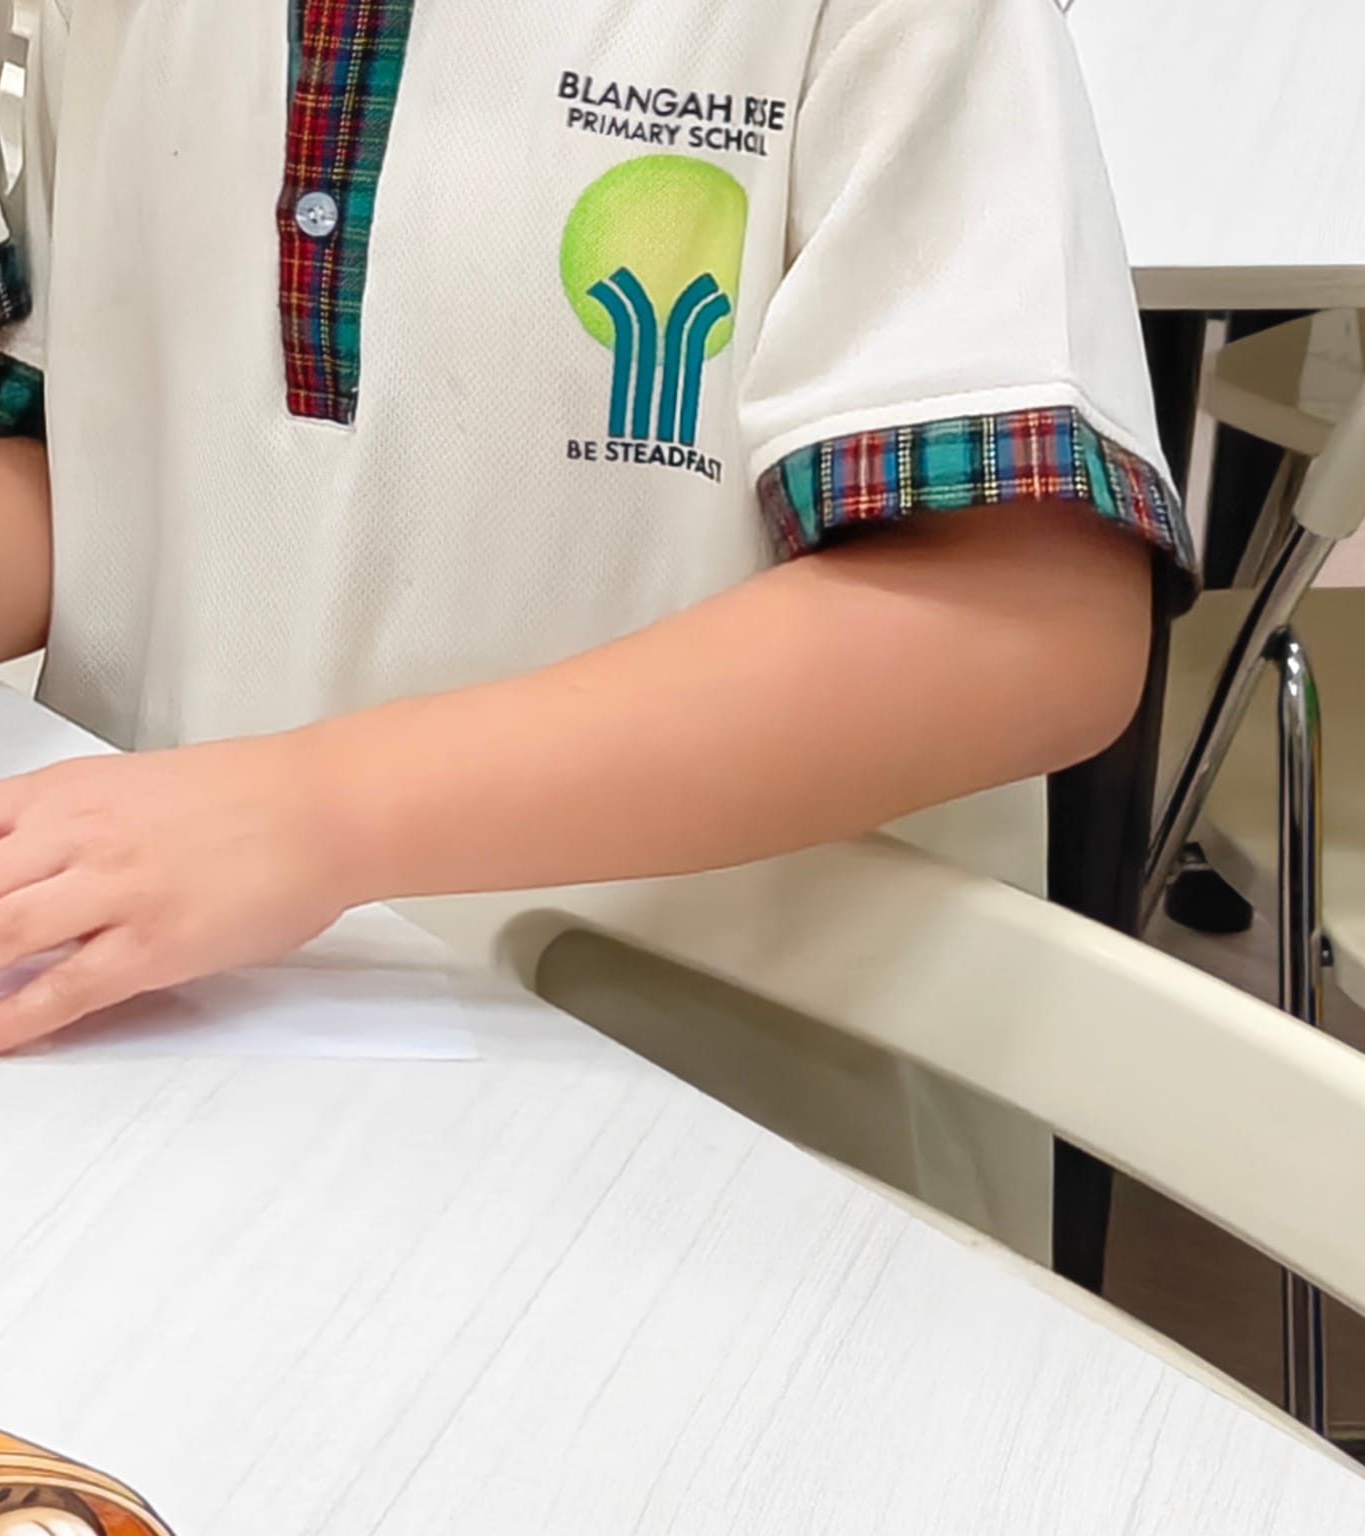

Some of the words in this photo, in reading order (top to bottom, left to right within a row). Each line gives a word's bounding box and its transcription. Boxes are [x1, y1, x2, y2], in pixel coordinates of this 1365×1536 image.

[557, 70, 732, 124] BLANGAH
[566, 106, 681, 146] PRIMARY
[567, 439, 598, 461] BE
